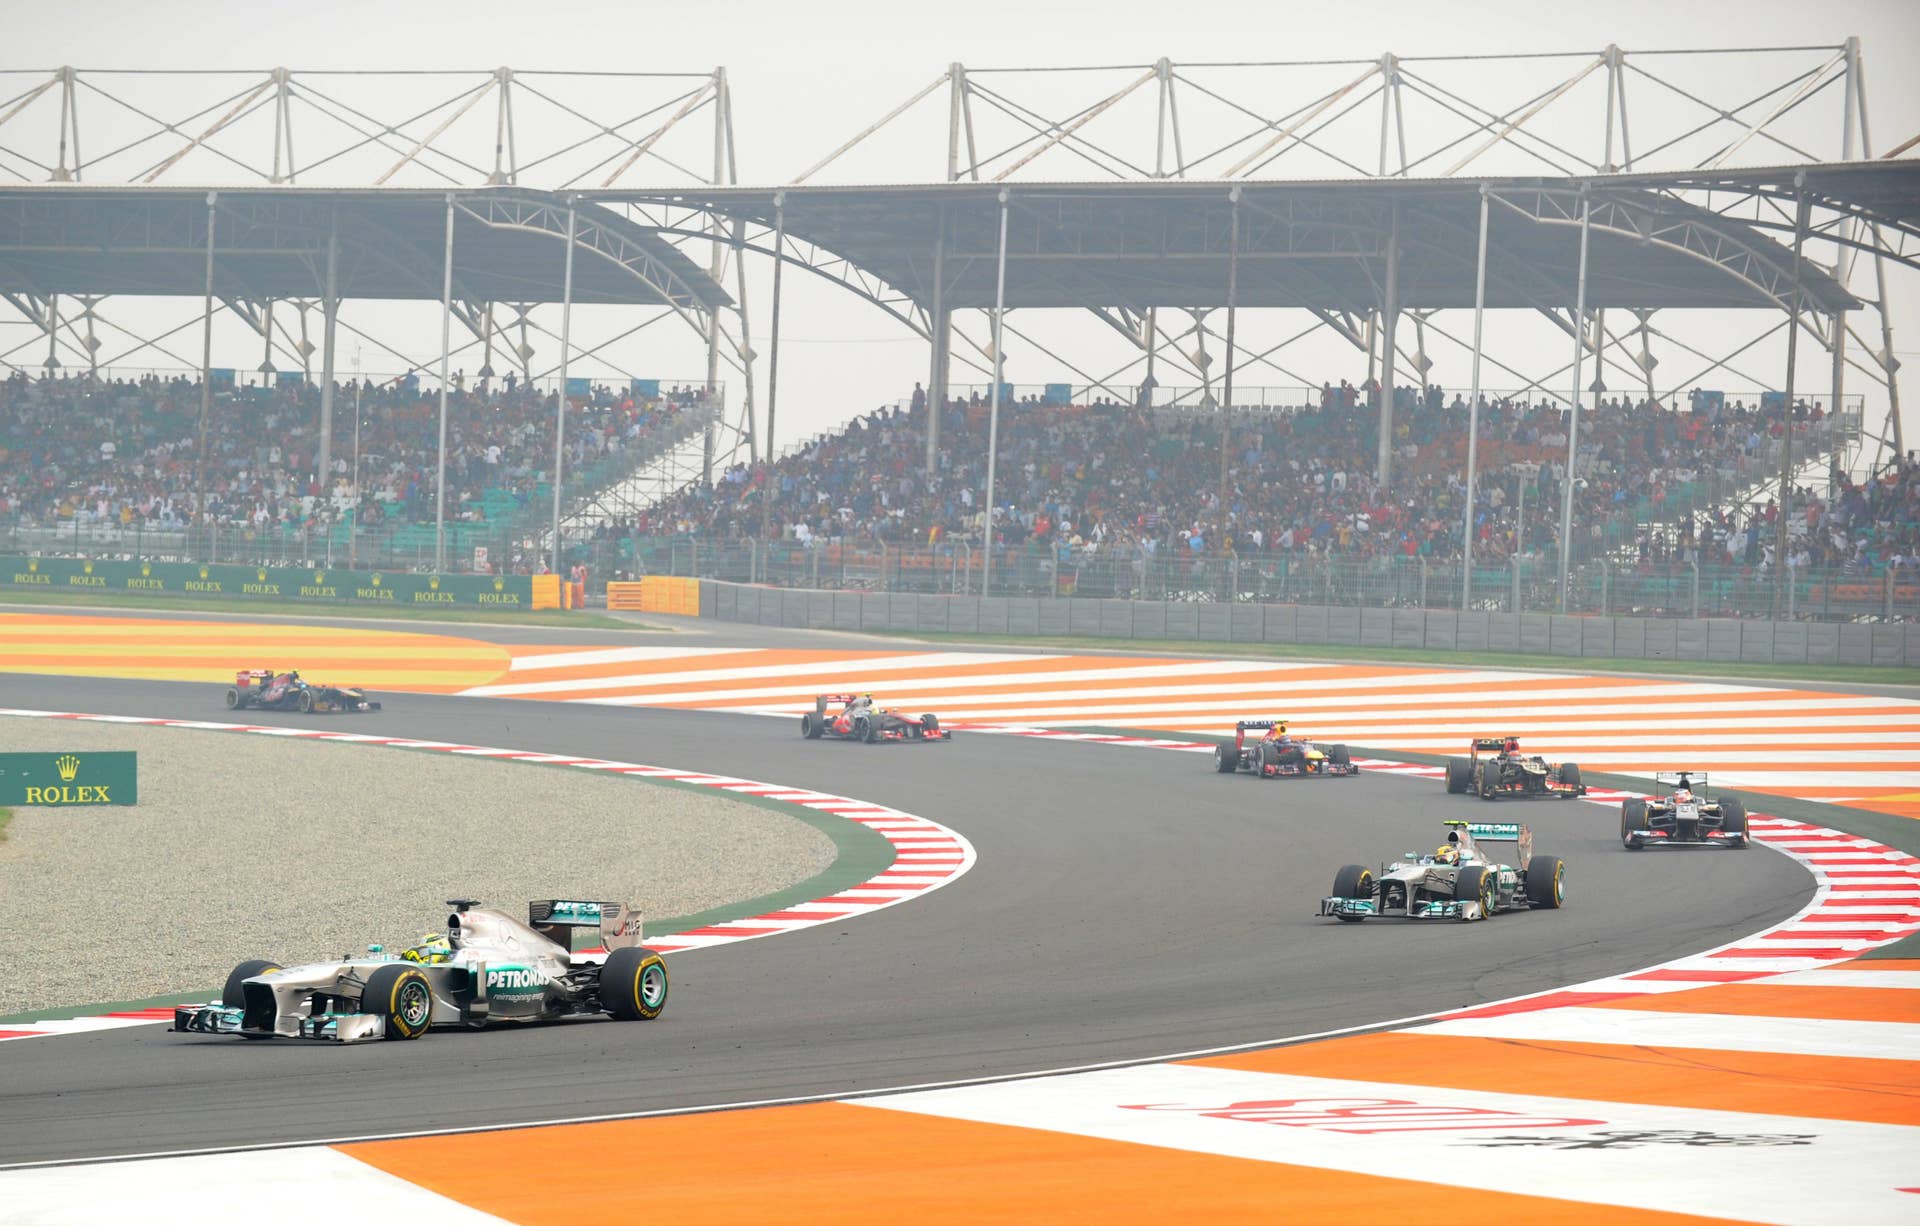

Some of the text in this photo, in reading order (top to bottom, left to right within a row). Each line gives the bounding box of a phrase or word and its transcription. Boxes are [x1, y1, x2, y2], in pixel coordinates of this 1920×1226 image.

[14, 573, 51, 585] ROLEX
[70, 575, 106, 587] ROLEX
[127, 578, 164, 590] ROLEX
[185, 580, 222, 592] ROLEX
[243, 583, 280, 594] ROLEX
[301, 585, 337, 597] ROLEX
[357, 588, 394, 600] ROLEX
[414, 591, 455, 603] ROLEX
[479, 592, 520, 604] ROLEX
[25, 786, 111, 804] ROLEX
[486, 968, 550, 988] PETRONAS
